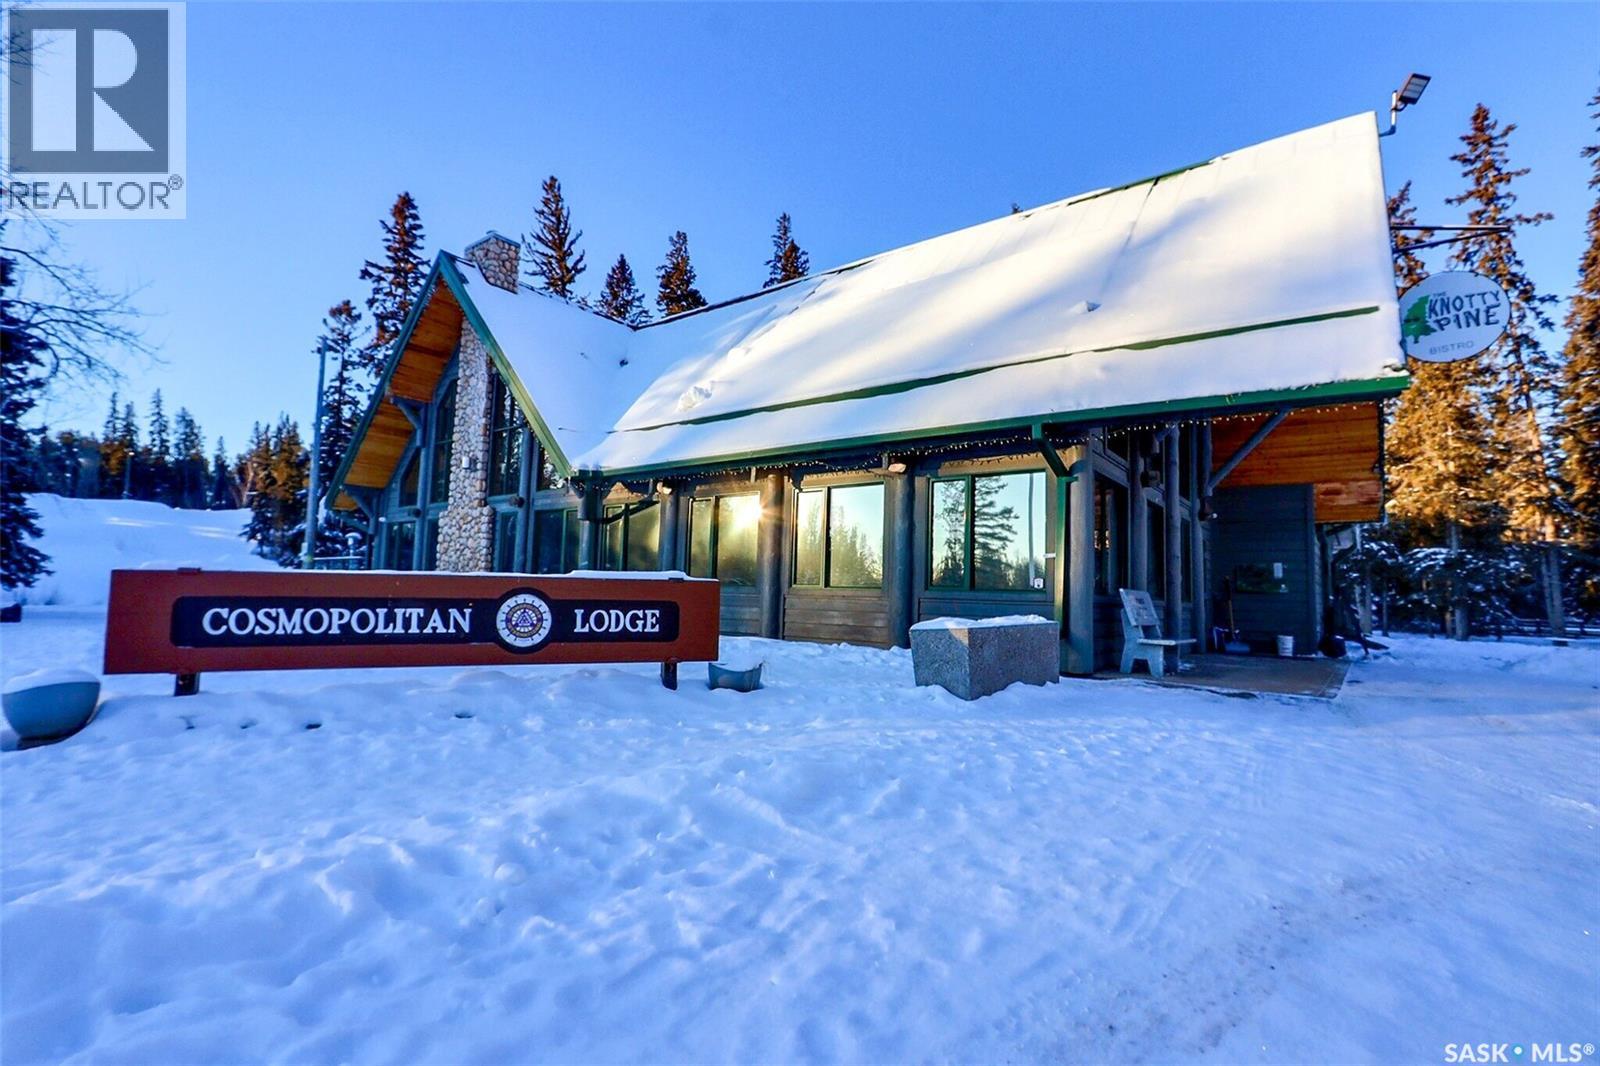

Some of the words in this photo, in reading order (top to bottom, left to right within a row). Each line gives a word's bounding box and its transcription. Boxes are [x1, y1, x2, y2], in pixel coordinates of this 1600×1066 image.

[1428, 290, 1500, 319] KNOTTY
[1434, 303, 1501, 331] PINE
[1429, 341, 1475, 355] BISTRO
[202, 608, 472, 635] COSMOPOLITAN
[574, 609, 660, 633] LODGE
